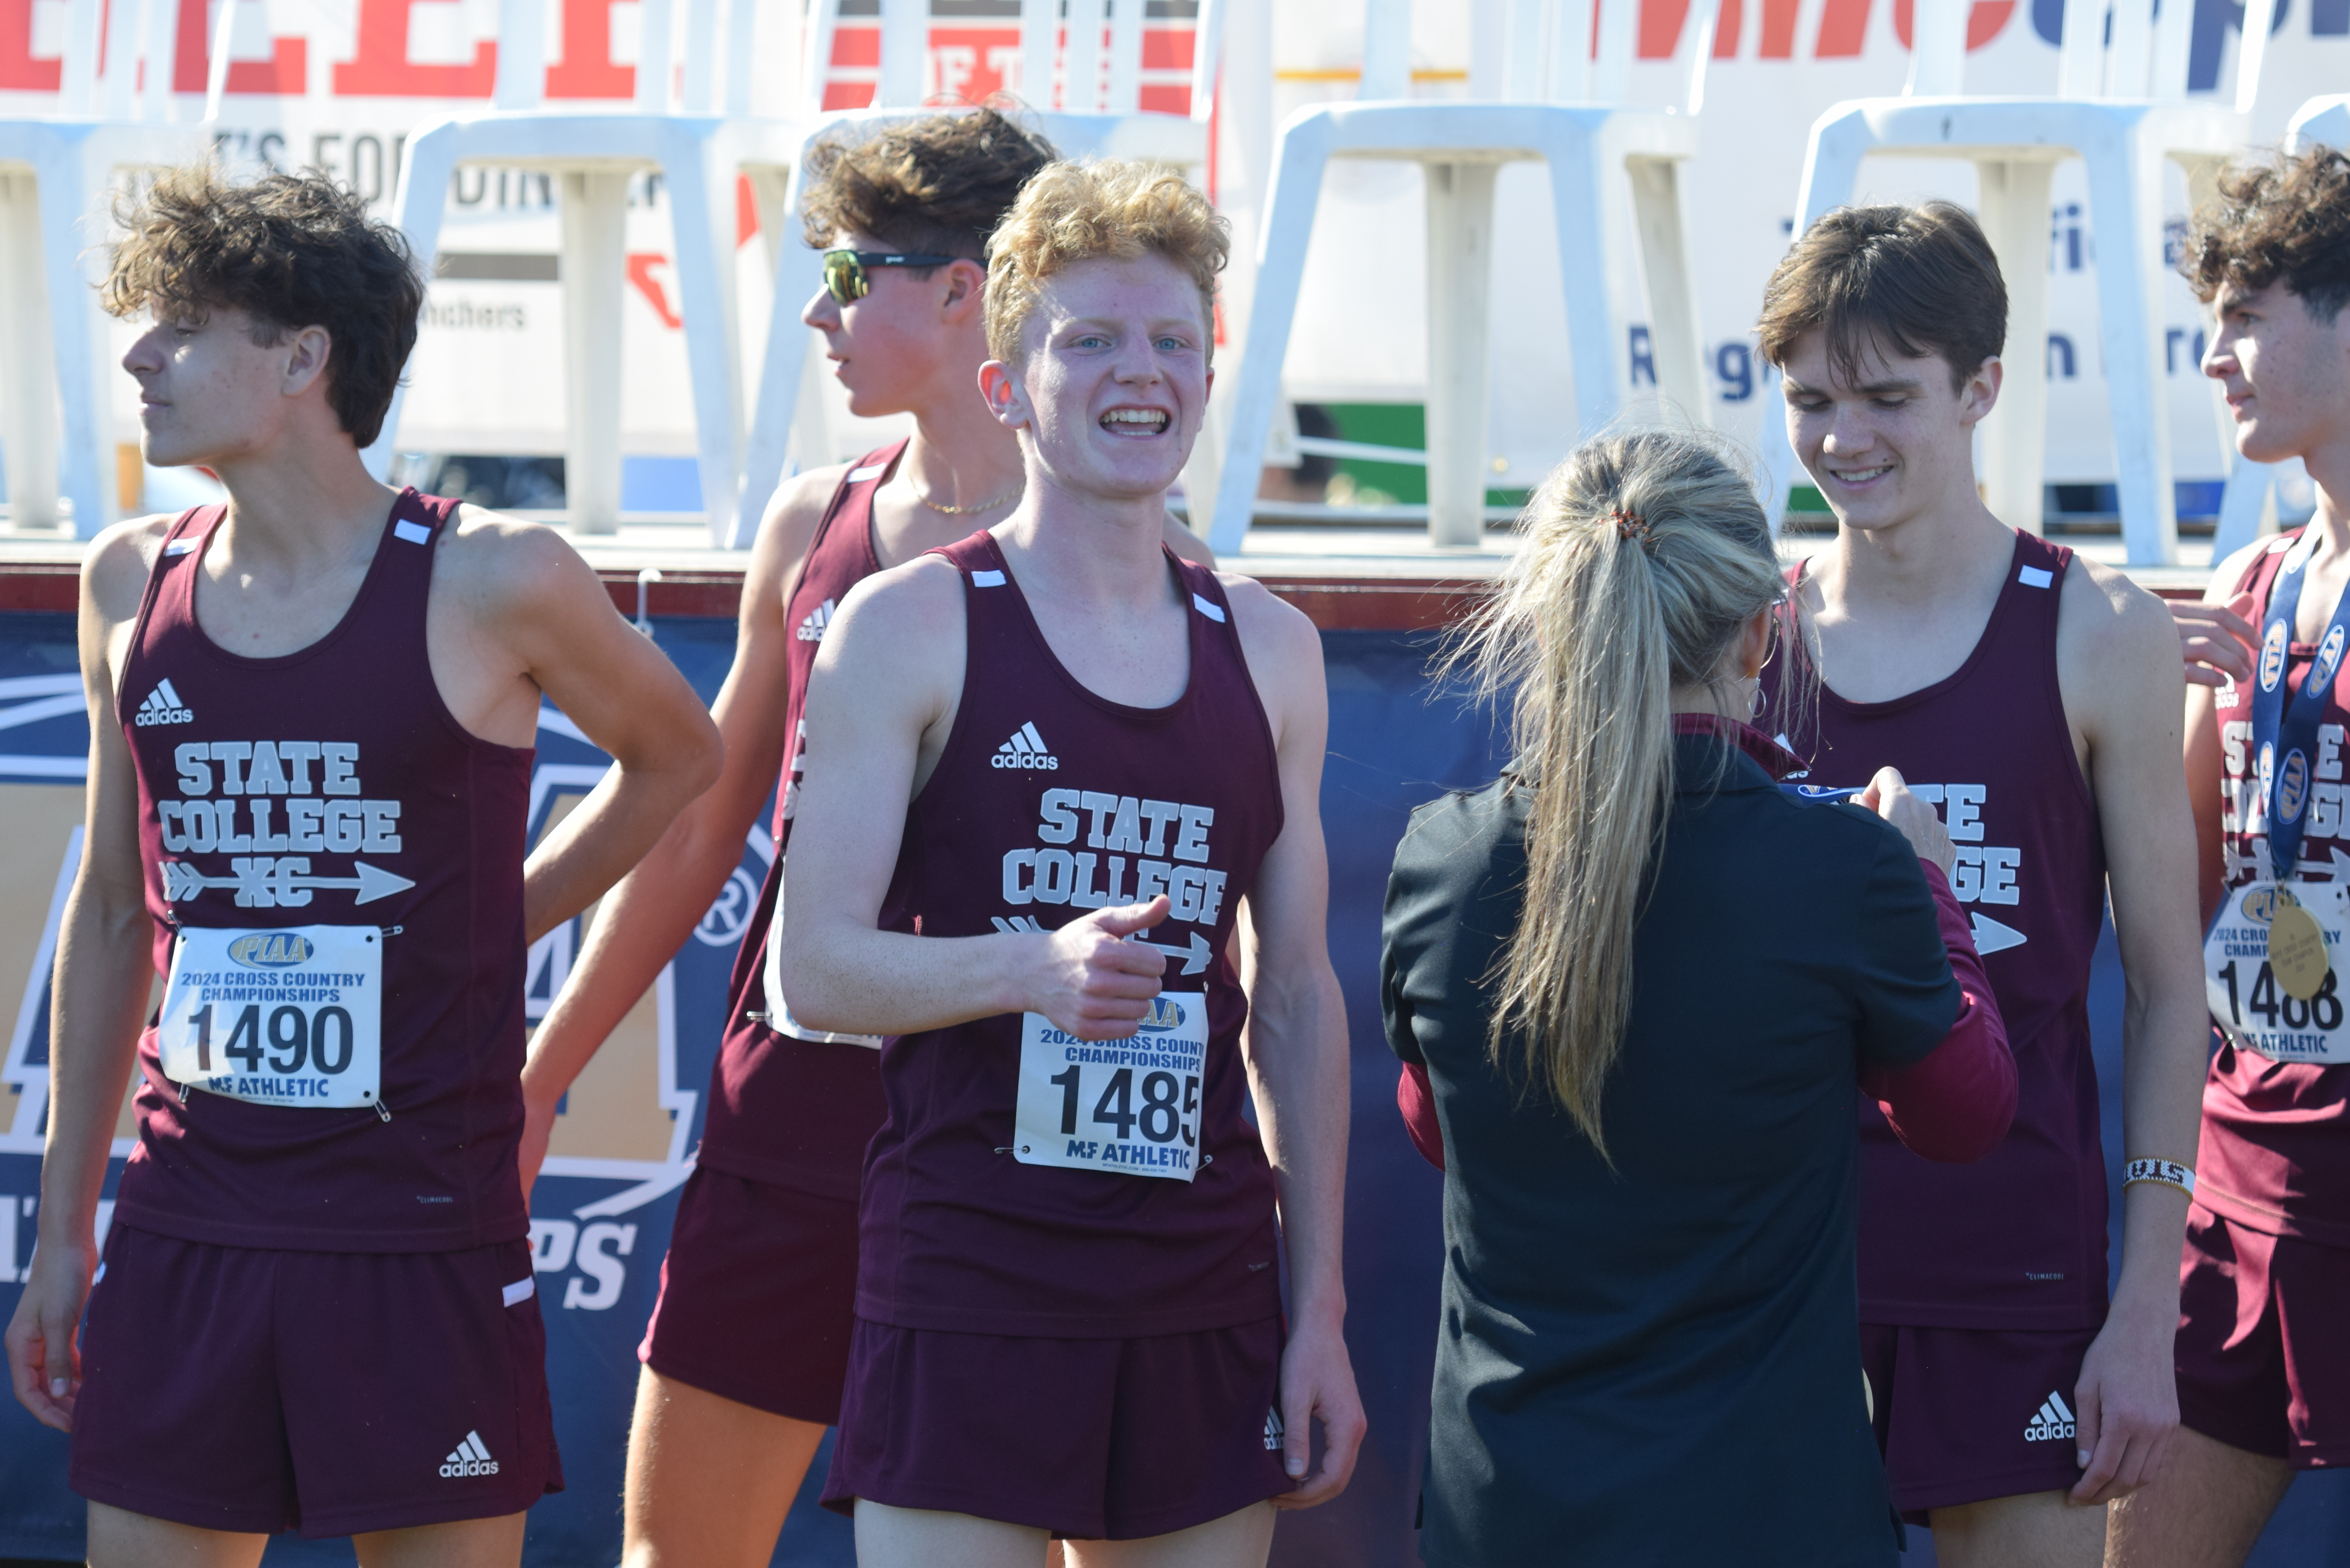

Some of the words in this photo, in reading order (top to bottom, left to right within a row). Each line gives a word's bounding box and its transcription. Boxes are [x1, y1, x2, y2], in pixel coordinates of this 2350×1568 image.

[135, 708, 194, 727] adidas
[174, 741, 361, 796] STATE
[991, 751, 1058, 770] adidas
[157, 798, 402, 854] COLLEGE
[1038, 788, 1214, 863] STATE
[231, 857, 314, 908] XC
[1003, 847, 1228, 926] COLLEGE
[2241, 929, 2271, 942] CRO
[237, 936, 307, 963] PIAA
[181, 972, 220, 987] 2024
[223, 972, 279, 986] CROSS
[282, 972, 365, 987] COUNTRY
[201, 987, 340, 1002] CHAMPIONSHIPS
[187, 1004, 353, 1076] 1490
[1156, 1037, 1204, 1058] COUNT
[2261, 1033, 2329, 1054] ATHLETIC
[1064, 1046, 1201, 1072] CHAMPIONSHIPS
[208, 1076, 233, 1094] MF
[237, 1077, 329, 1098] ATHLETIC
[1050, 1064, 1200, 1148] 1485
[1066, 1139, 1099, 1160] MF
[1101, 1143, 1190, 1170] ATHLETIC
[2024, 1421, 2075, 1442] adida
[439, 1460, 500, 1478] adidas
